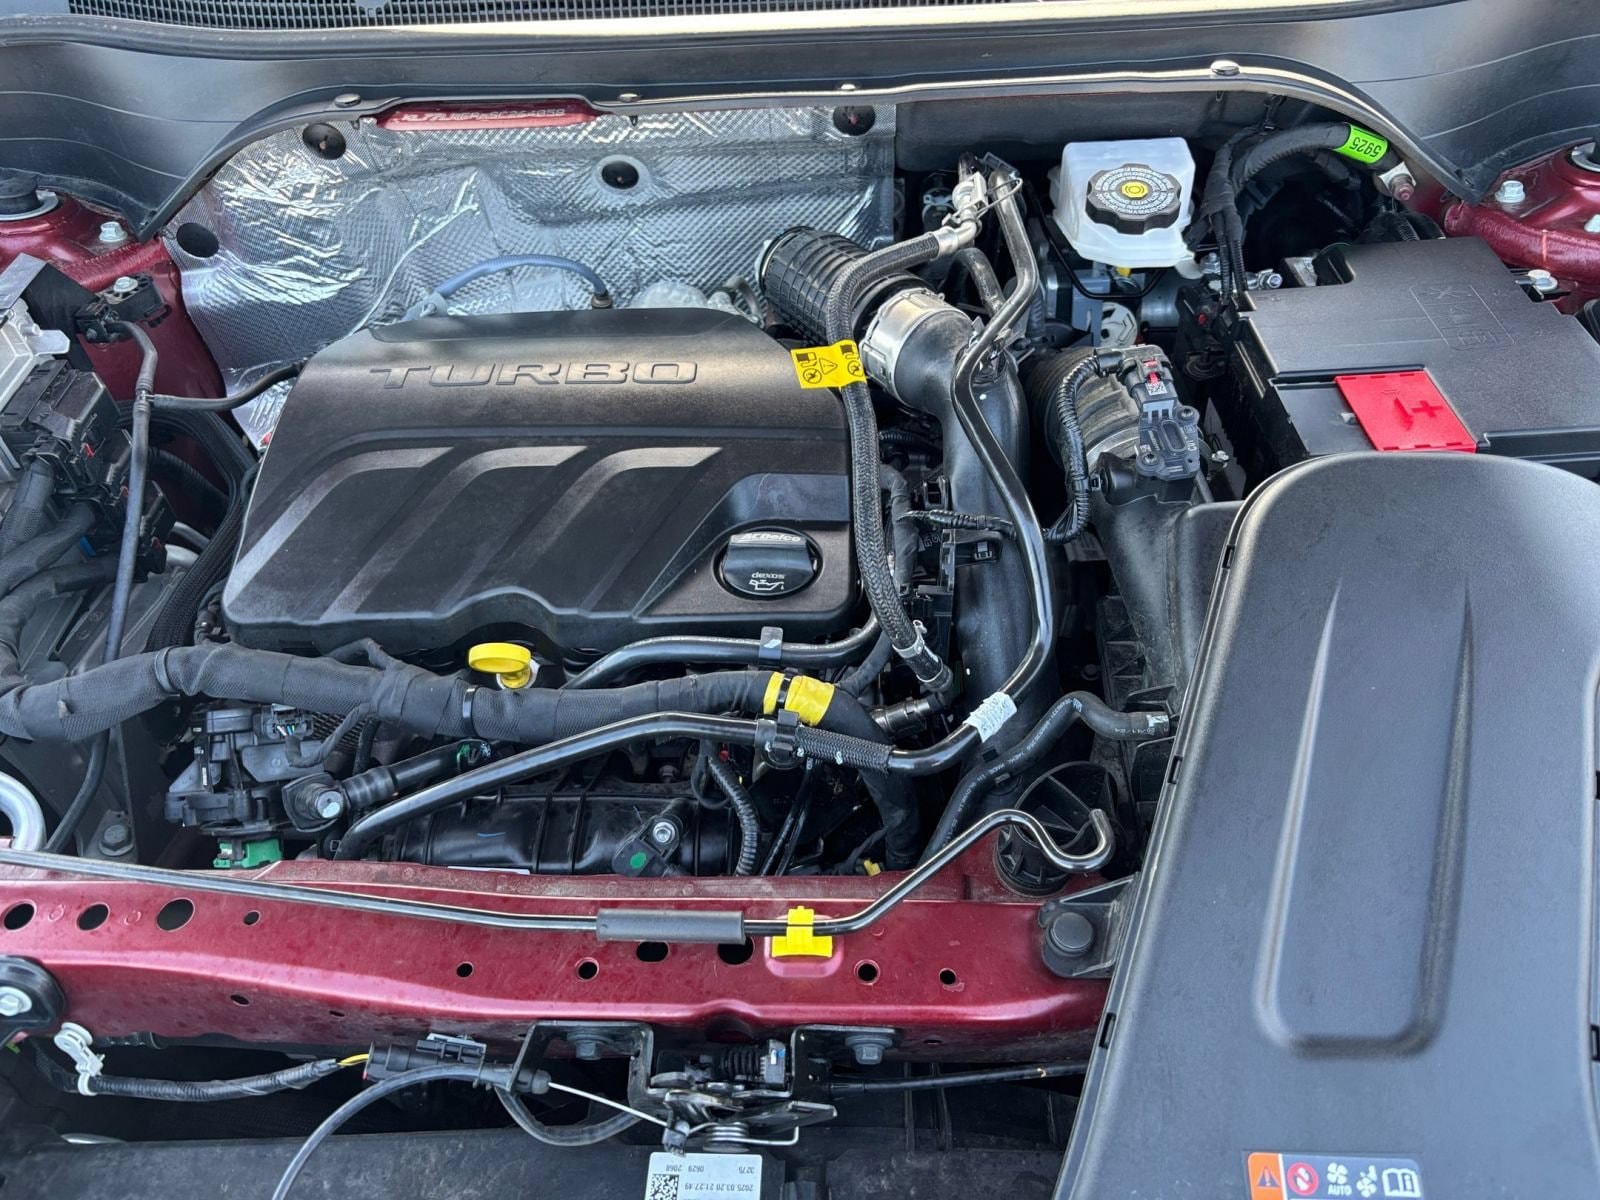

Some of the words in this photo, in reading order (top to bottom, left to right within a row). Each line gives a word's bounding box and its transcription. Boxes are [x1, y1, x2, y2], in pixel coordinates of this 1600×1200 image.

[1349, 136, 1382, 158] 5925
[369, 361, 698, 390] TURBO
[740, 532, 801, 542] ACDelco
[751, 571, 785, 580] dexos
[1328, 1183, 1352, 1196] AUTO
